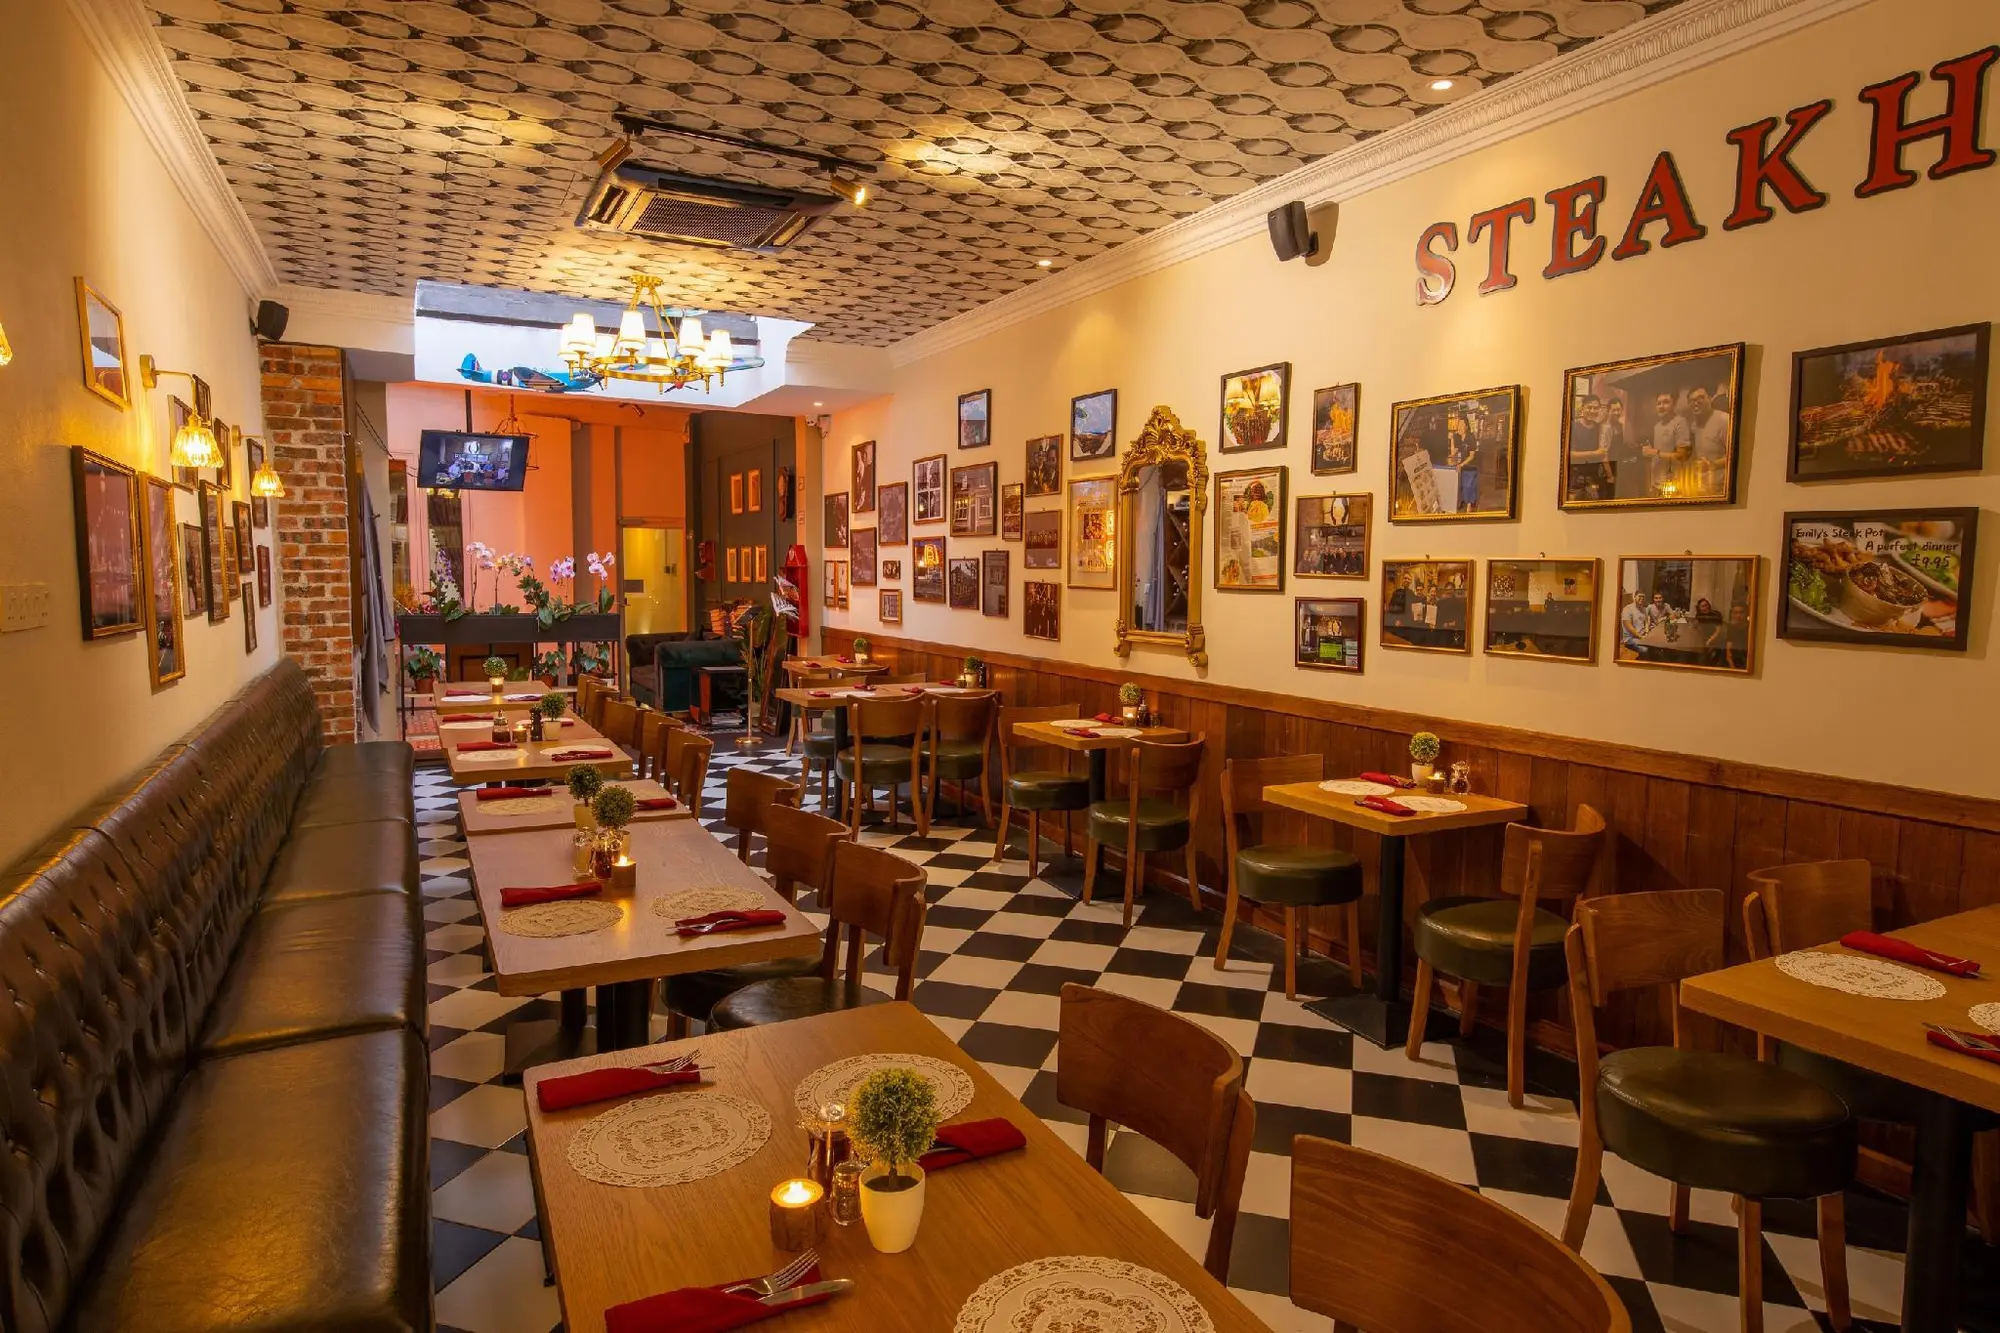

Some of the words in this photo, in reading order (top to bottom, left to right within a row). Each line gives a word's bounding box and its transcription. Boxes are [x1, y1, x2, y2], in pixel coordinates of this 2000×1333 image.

[1415, 45, 2000, 306] STEAKH
[1796, 528, 1828, 539] Emily's
[1865, 528, 1885, 538] Pot
[1865, 540, 1874, 551] A
[1922, 541, 1959, 551] dinner
[1912, 554, 1951, 569] £9.95
